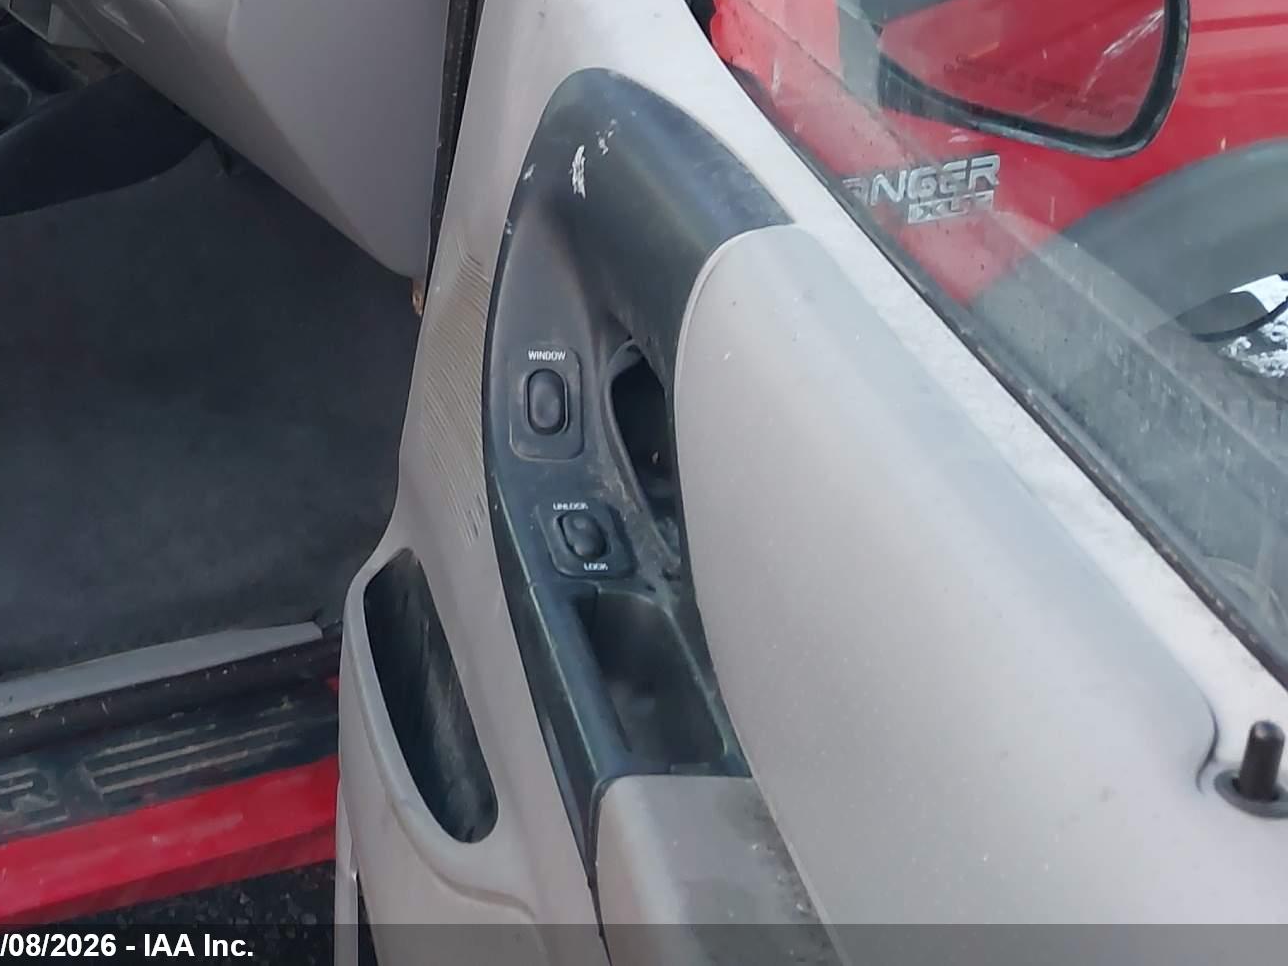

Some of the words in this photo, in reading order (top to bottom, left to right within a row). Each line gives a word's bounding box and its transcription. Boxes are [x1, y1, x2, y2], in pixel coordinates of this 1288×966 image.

[528, 350, 566, 361] WINDOW
[553, 502, 589, 510] UNLOCK
[583, 562, 608, 570] LOCK
